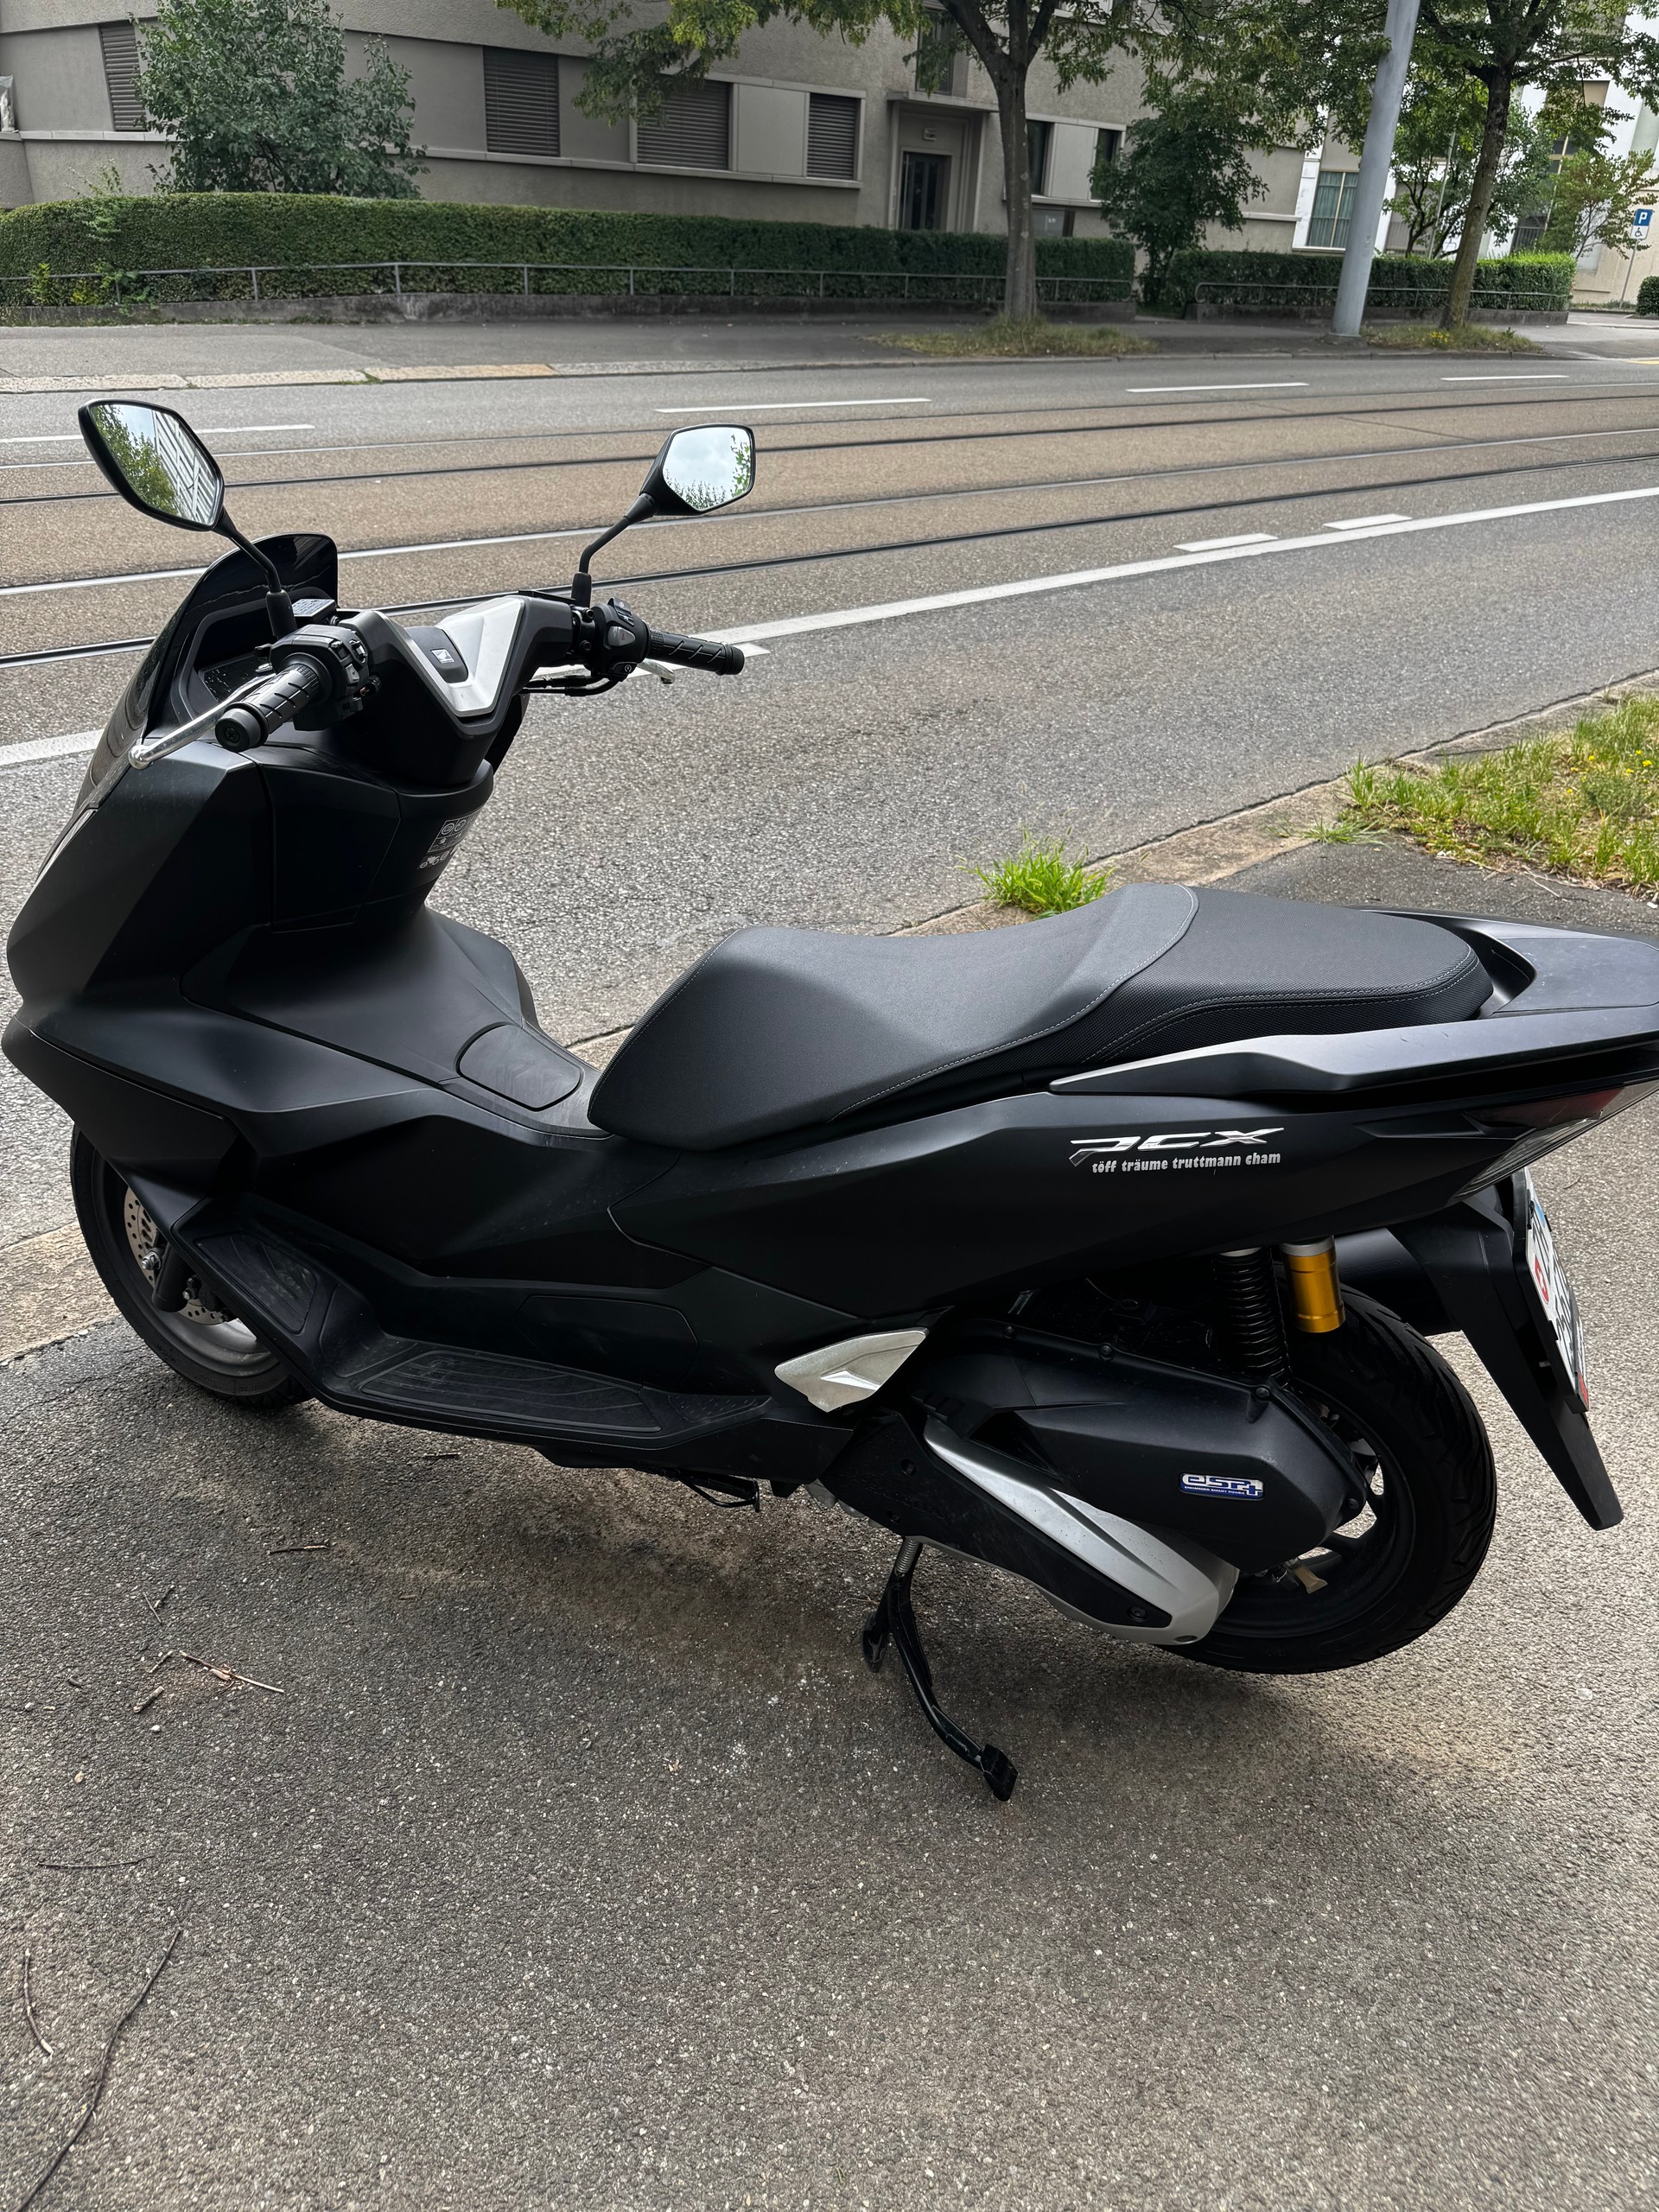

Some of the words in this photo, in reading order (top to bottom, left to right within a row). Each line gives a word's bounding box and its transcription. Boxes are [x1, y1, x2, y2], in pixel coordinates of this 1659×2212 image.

[1638, 212, 1648, 225] P
[1069, 1128, 1284, 1166] PCX
[1092, 1159, 1117, 1173] töff
[1122, 1158, 1168, 1172] träume
[1172, 1155, 1242, 1169] truttmann
[1245, 1152, 1281, 1166] cham
[1532, 1208, 1551, 1286] ZH
